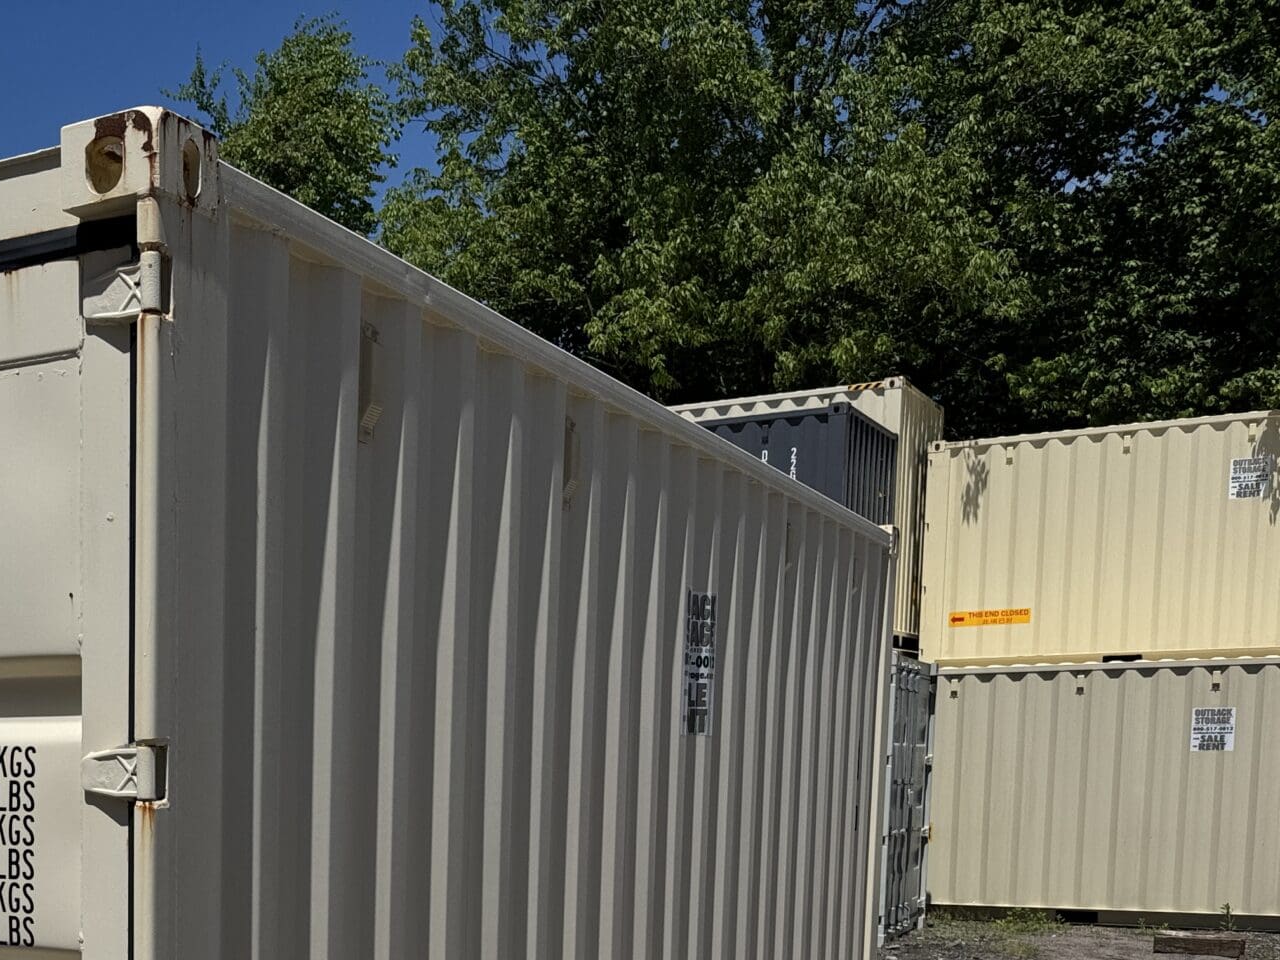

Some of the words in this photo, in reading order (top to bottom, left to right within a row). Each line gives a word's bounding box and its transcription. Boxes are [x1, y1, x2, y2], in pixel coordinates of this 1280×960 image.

[1232, 458, 1268, 466] OUTBACK
[1232, 466, 1266, 474] STORAGE
[1238, 482, 1261, 491] SALE
[1236, 490, 1261, 498] RENT
[1001, 608, 1029, 617] CLOSED
[1195, 709, 1232, 717] OUTBACK
[1200, 735, 1225, 743] SALE
